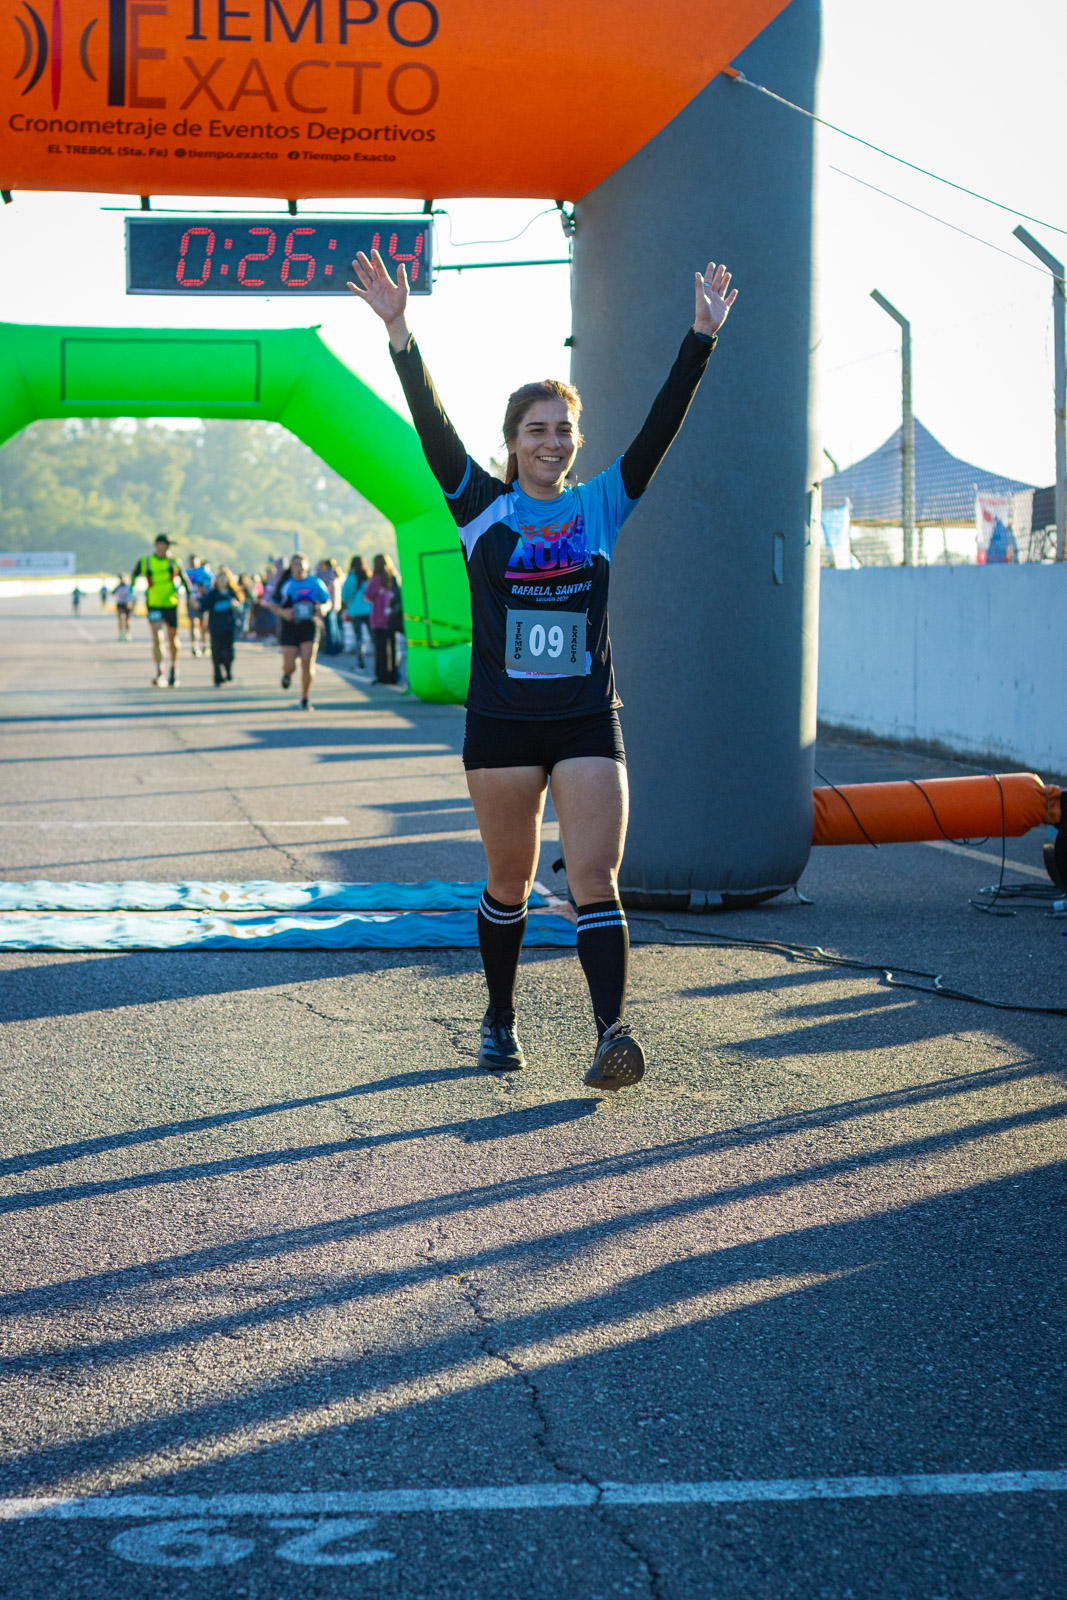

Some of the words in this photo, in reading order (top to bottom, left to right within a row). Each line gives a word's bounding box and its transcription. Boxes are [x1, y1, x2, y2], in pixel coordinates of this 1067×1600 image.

[129, 4, 440, 116] EXACTO
[9, 113, 166, 139] Cronometraje
[173, 118, 201, 137] de
[209, 120, 300, 139] Eventos
[307, 121, 436, 144] Deportivos
[48, 144, 62, 153] EL
[65, 145, 114, 155] TREBOL
[118, 146, 146, 156] (Sta.
[149, 147, 168, 157] Fe)
[188, 149, 279, 161] tiempo.exacto
[302, 151, 350, 162] Tiempo
[354, 152, 397, 162] Exacto
[508, 536, 585, 570] RUN
[511, 584, 553, 596] RAFAELA,
[514, 621, 523, 660] TIEMPO
[529, 624, 564, 658] 09
[570, 625, 578, 663] EXACTO
